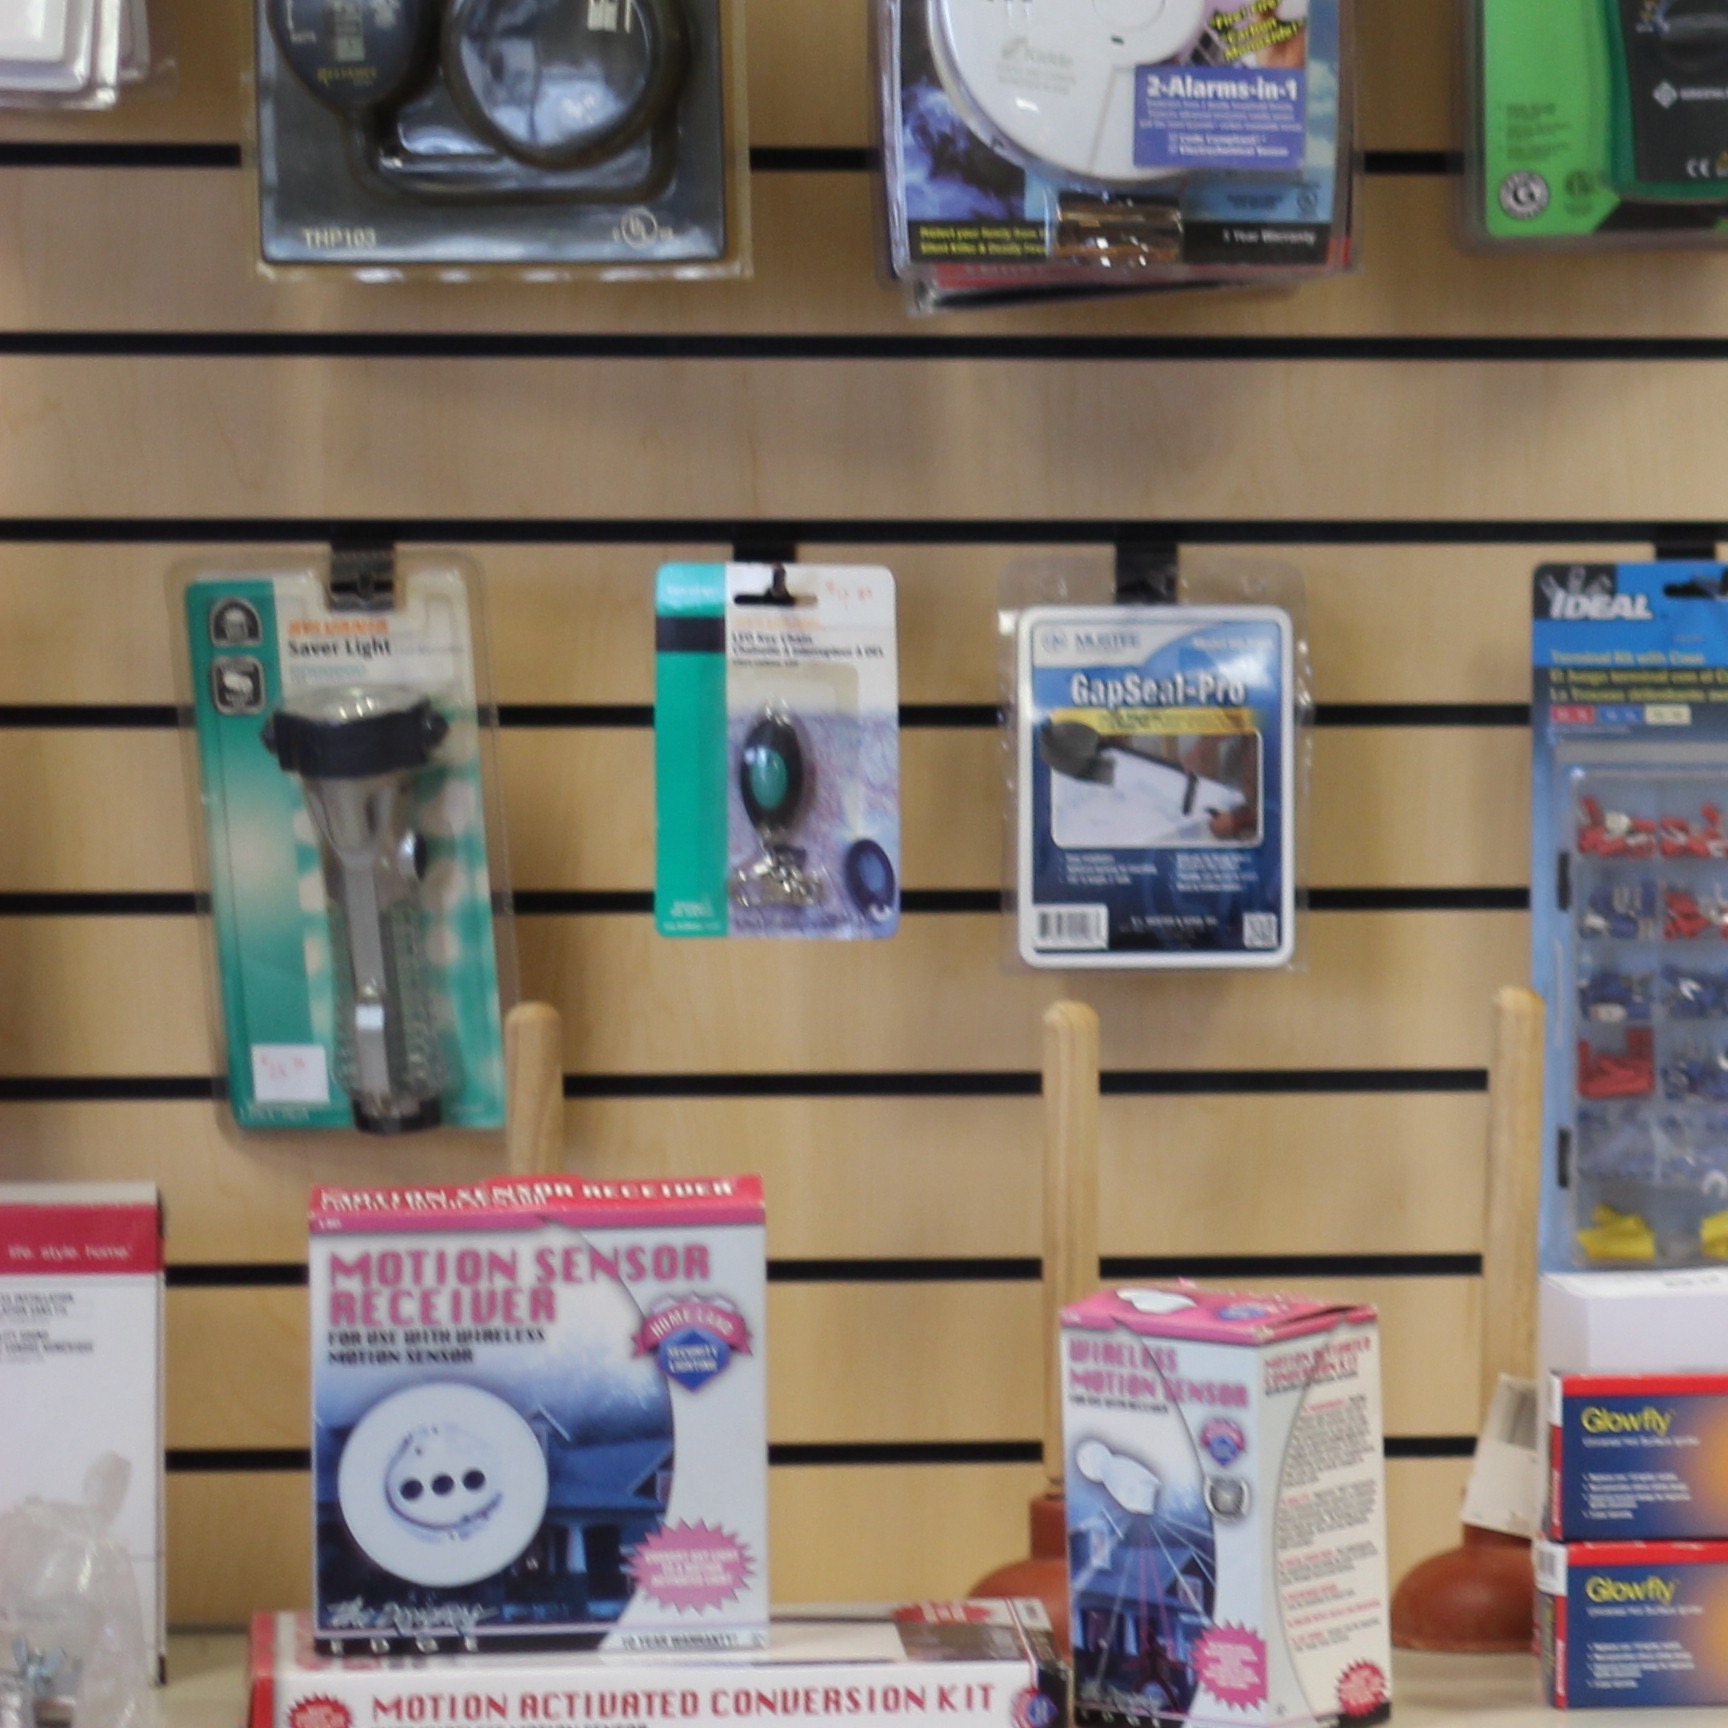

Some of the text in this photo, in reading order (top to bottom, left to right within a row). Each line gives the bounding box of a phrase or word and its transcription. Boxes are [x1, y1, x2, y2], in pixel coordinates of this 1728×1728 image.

[1146, 74, 1298, 101] 2-Alarms-in-1
[1550, 593, 1653, 620] IDEAL
[288, 638, 392, 659] Saver Light
[1070, 672, 1246, 710] GapSeal-Pro
[328, 1241, 712, 1288] MOTION SENSOR
[328, 1285, 558, 1328] RECEIVER
[328, 1326, 547, 1347] FOR USE WITH WIRELESS
[649, 1308, 690, 1339] HOME
[328, 1347, 474, 1367] MOTION SENSOR
[1069, 1338, 1178, 1372] WIRELESS
[1069, 1369, 1248, 1408] MOTION SENSOR
[1580, 1405, 1672, 1436] Glowfly
[1585, 1574, 1677, 1605] Glowfly
[371, 1682, 996, 1723] MOTION ACTIVATED CONVERSION KIT
